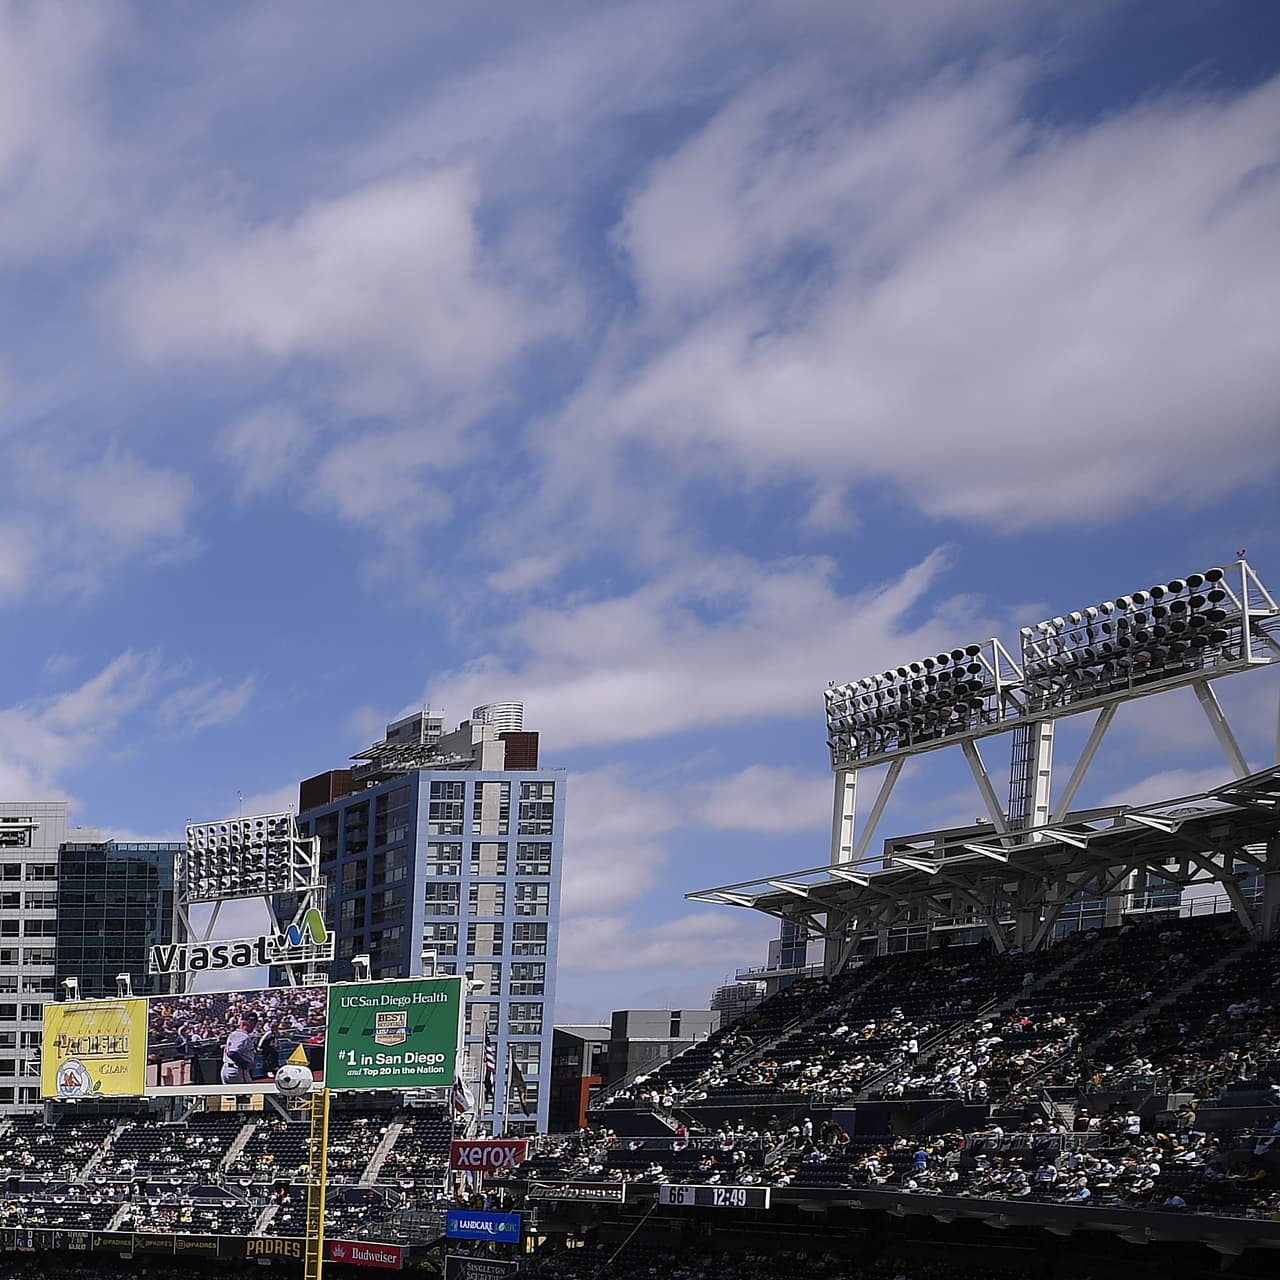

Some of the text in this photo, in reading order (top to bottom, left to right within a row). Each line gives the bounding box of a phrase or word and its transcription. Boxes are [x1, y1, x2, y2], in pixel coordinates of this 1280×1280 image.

[153, 937, 272, 974] Viasat
[341, 992, 448, 1008] UC San Diego Health
[338, 1049, 445, 1066] #1 in San Diego
[363, 1068, 378, 1076] Top
[417, 1066, 444, 1074] Nation
[458, 1146, 516, 1167] xerox
[712, 1188, 747, 1207] 12:49
[460, 1219, 493, 1231] LANDCARE
[246, 1239, 301, 1258] PADRES
[351, 1247, 398, 1264] Budweiser
[466, 1262, 506, 1275] SINGLETON
